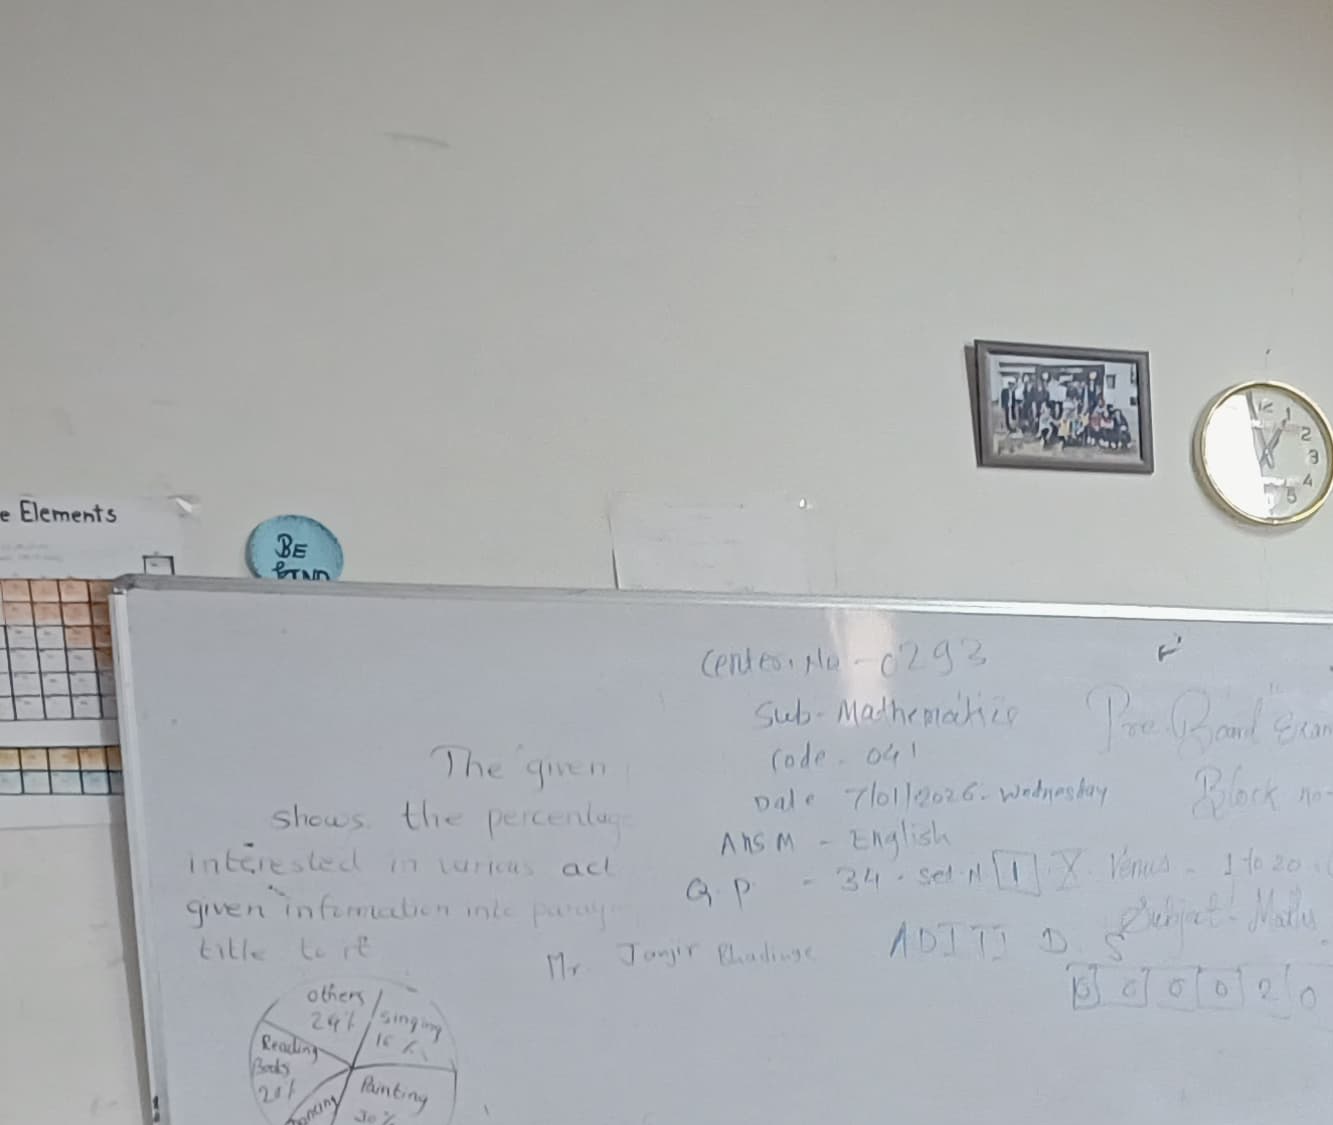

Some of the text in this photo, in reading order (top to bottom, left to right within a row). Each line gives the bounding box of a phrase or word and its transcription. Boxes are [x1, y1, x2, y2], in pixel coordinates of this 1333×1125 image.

[1301, 426, 1312, 441] 2
[1308, 449, 1319, 465] 3
[1303, 473, 1313, 487] 4
[20, 500, 117, 524] Elements
[275, 533, 308, 559] BE
[430, 744, 607, 792] The given
[400, 799, 463, 830] the
[849, 820, 951, 861] English
[185, 848, 361, 876] interested
[185, 898, 264, 929] given
[200, 935, 267, 962] title
[261, 1034, 319, 1065] Reading
